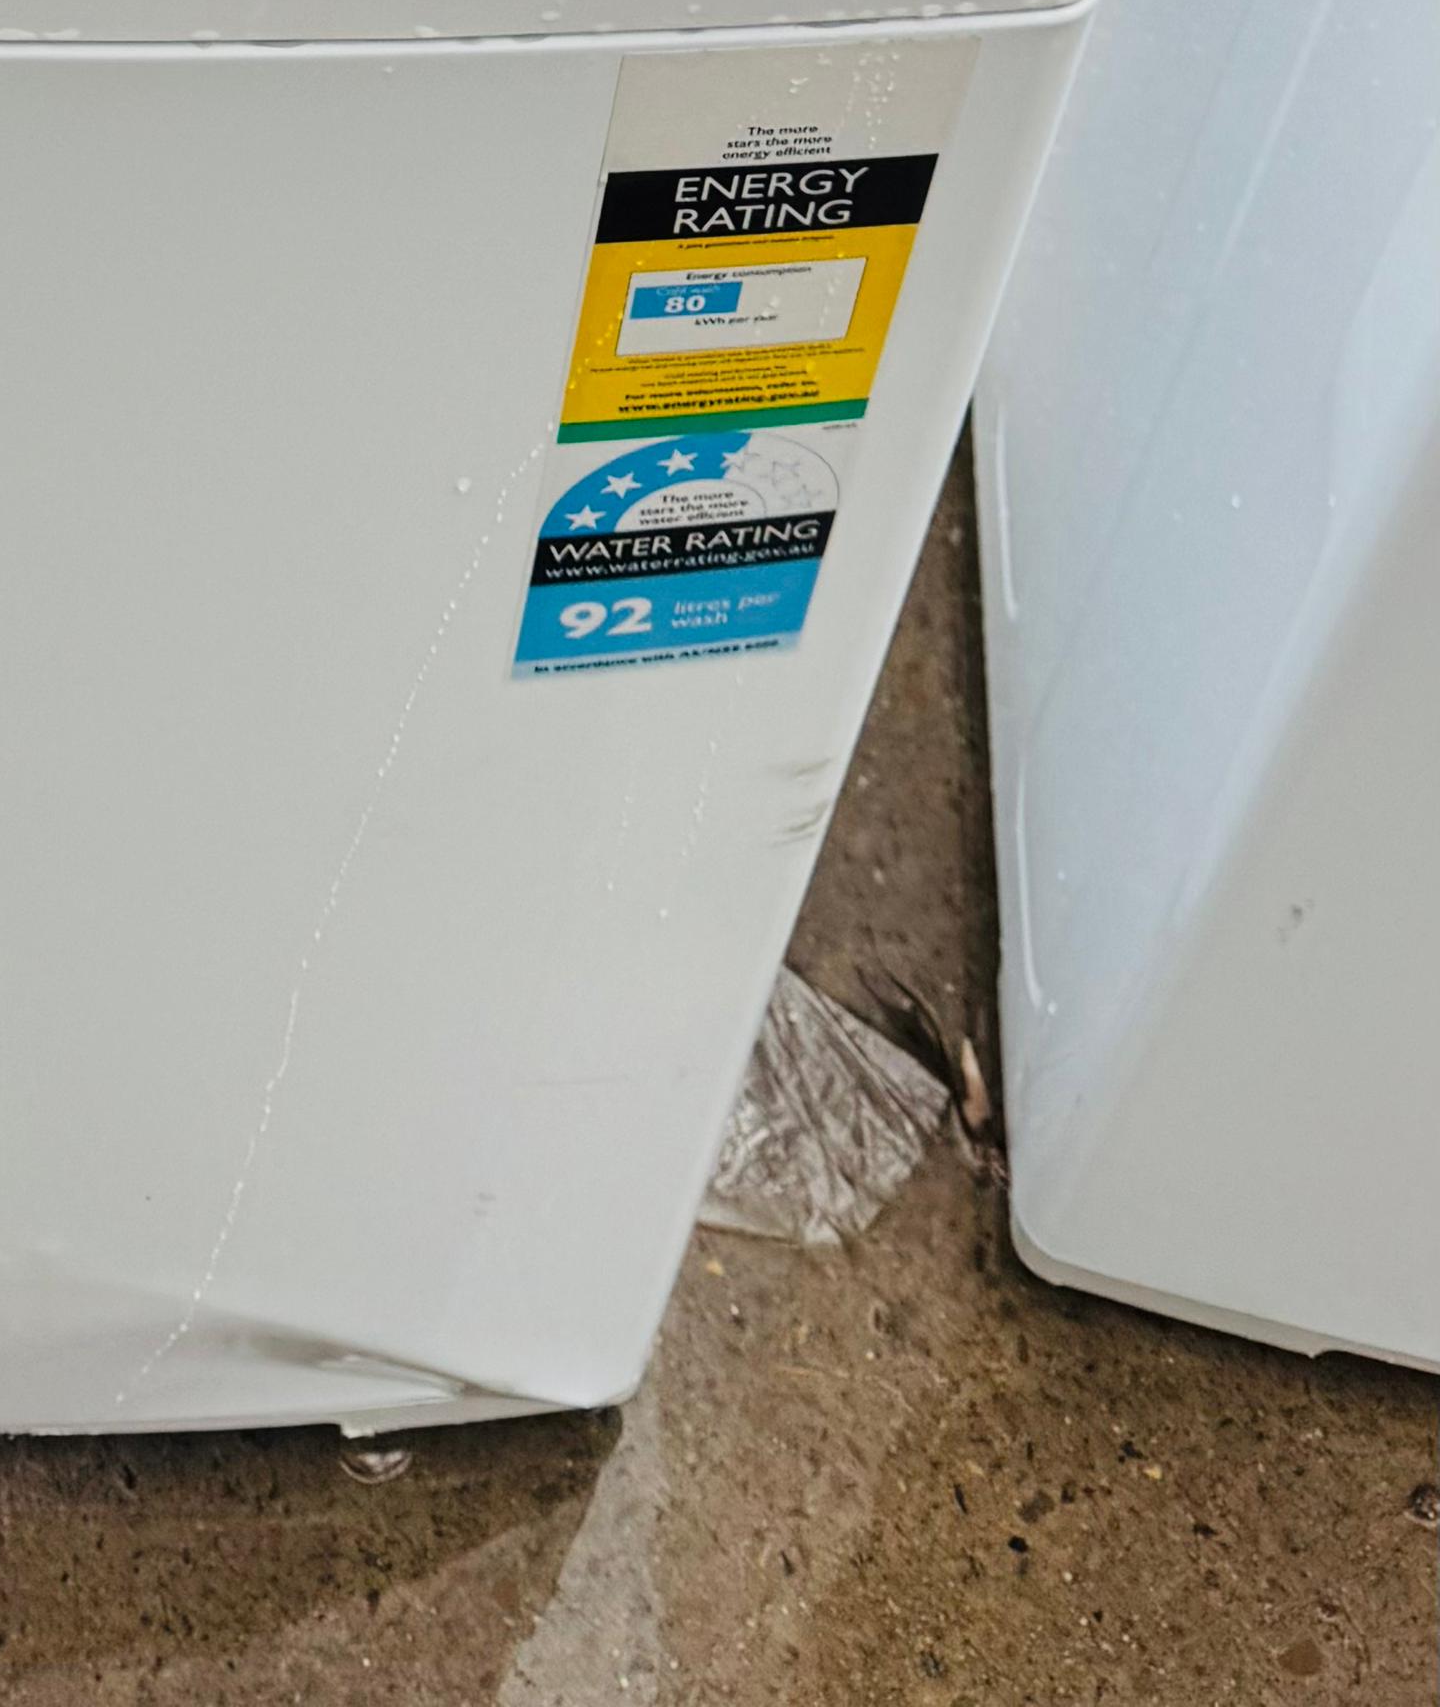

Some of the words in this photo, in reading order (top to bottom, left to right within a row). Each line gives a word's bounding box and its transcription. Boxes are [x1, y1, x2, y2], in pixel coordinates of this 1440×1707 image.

[748, 126, 775, 137] The
[778, 125, 819, 136] more
[727, 139, 761, 149] stars
[765, 137, 789, 147] the
[793, 136, 832, 145] more
[722, 150, 771, 160] energy
[775, 146, 832, 157] efficient
[674, 166, 870, 203] ENERGY
[672, 198, 854, 235] RATING
[686, 271, 728, 282] Energy
[664, 295, 706, 314] 80
[549, 534, 673, 563] WATER
[684, 519, 821, 552] RATING
[674, 598, 731, 615] litres
[738, 592, 781, 611] per
[559, 596, 653, 639] 92
[671, 612, 728, 629] wash
